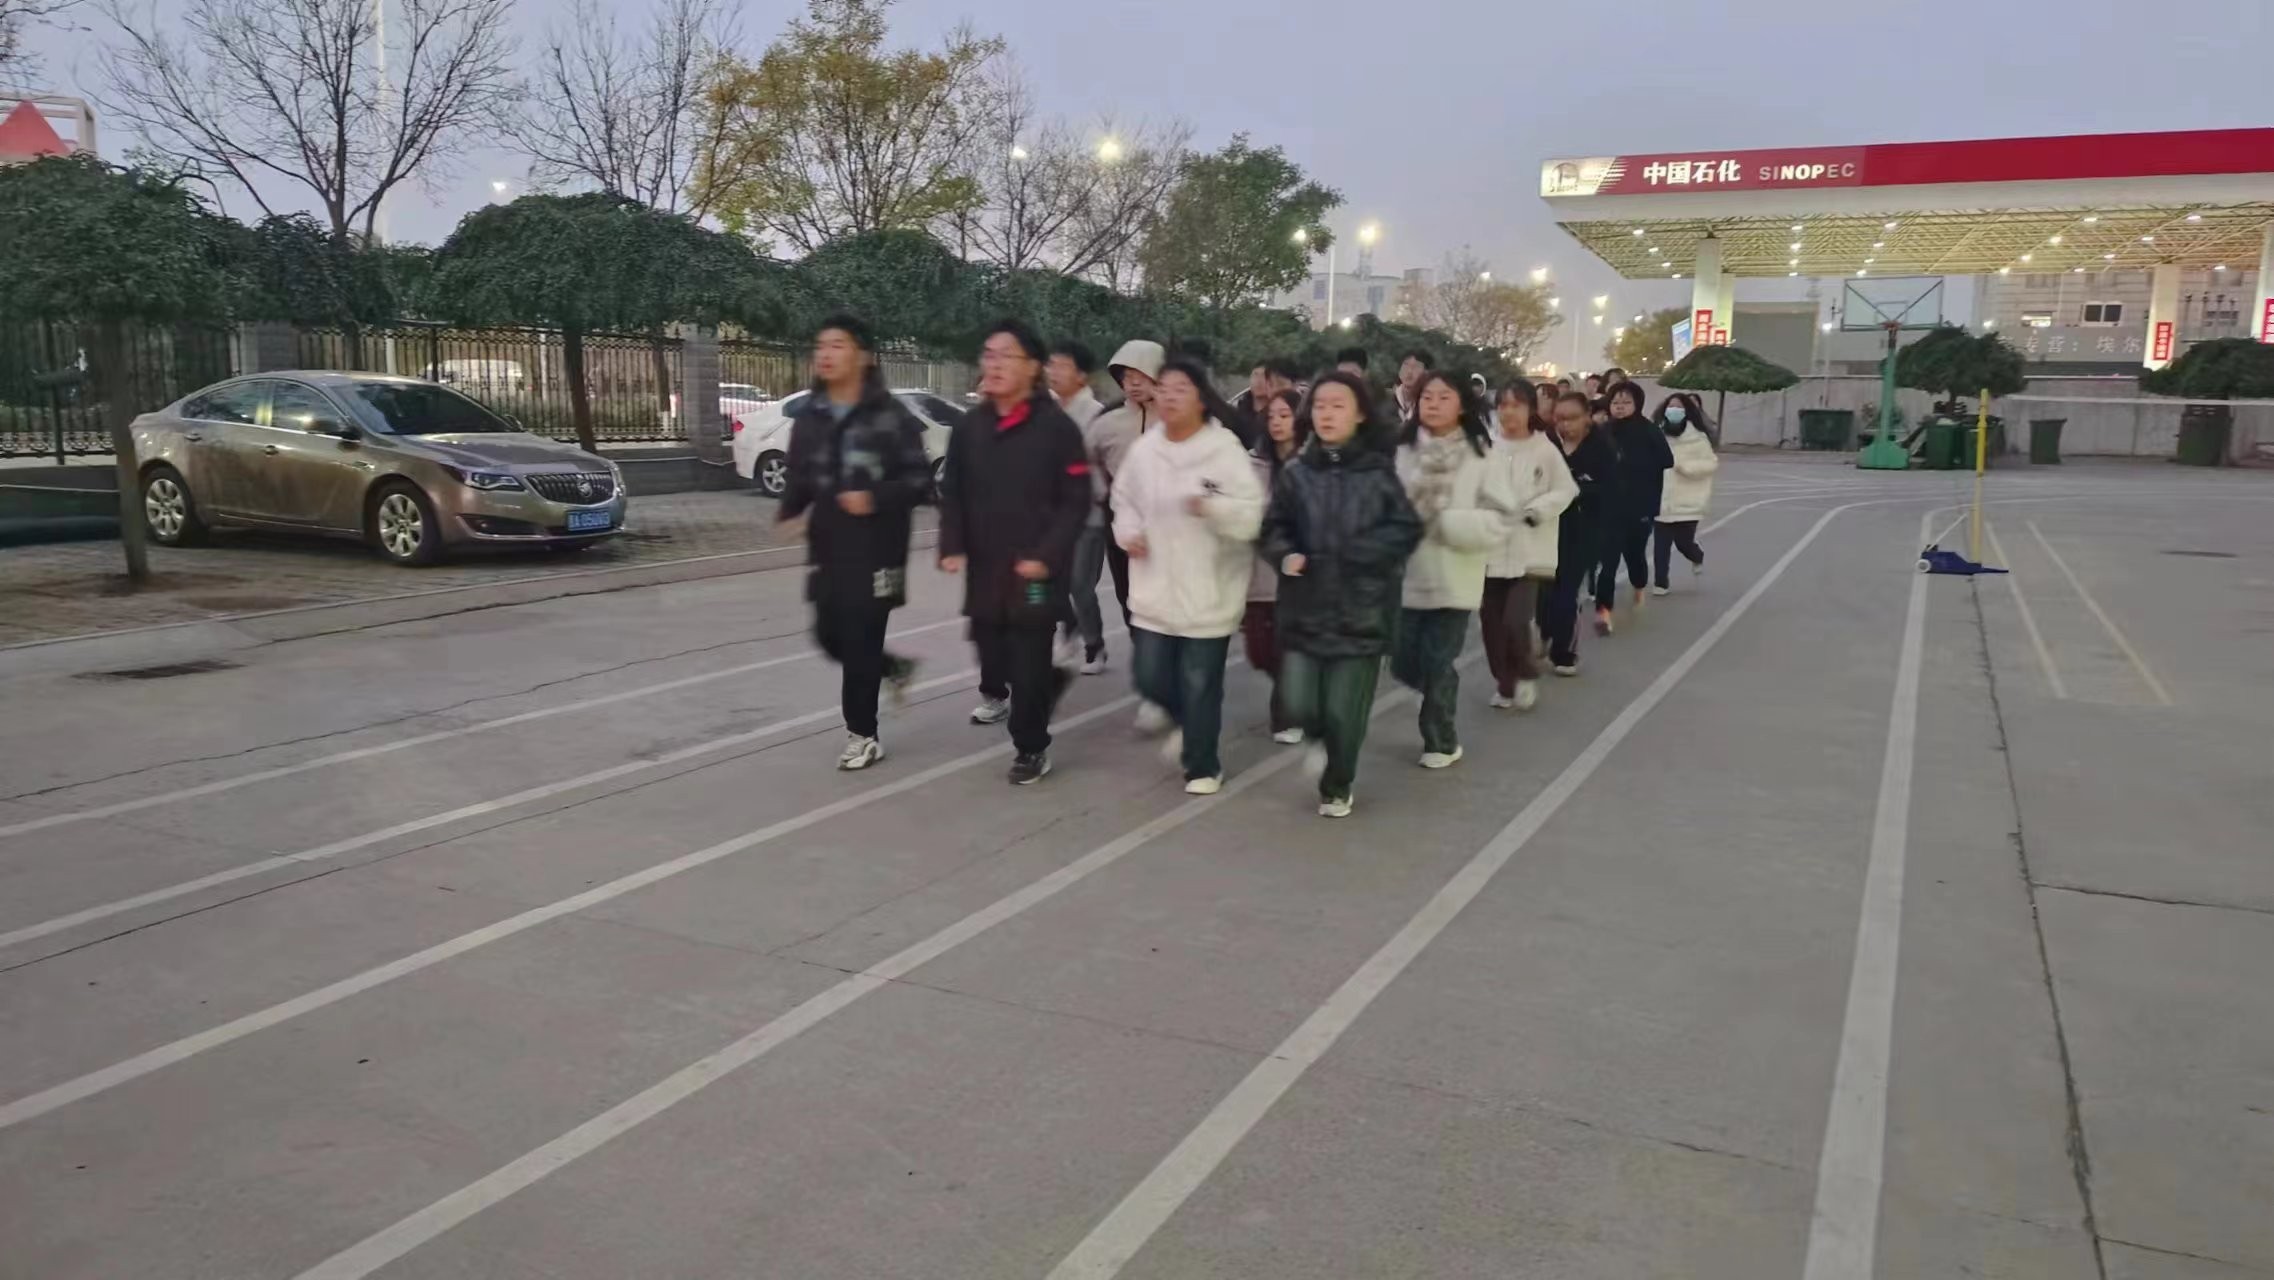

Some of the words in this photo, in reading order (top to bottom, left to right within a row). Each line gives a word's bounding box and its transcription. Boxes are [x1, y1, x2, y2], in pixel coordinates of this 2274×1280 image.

[1643, 159, 1741, 185] 中国石化
[1759, 163, 1855, 181] SINOPEC
